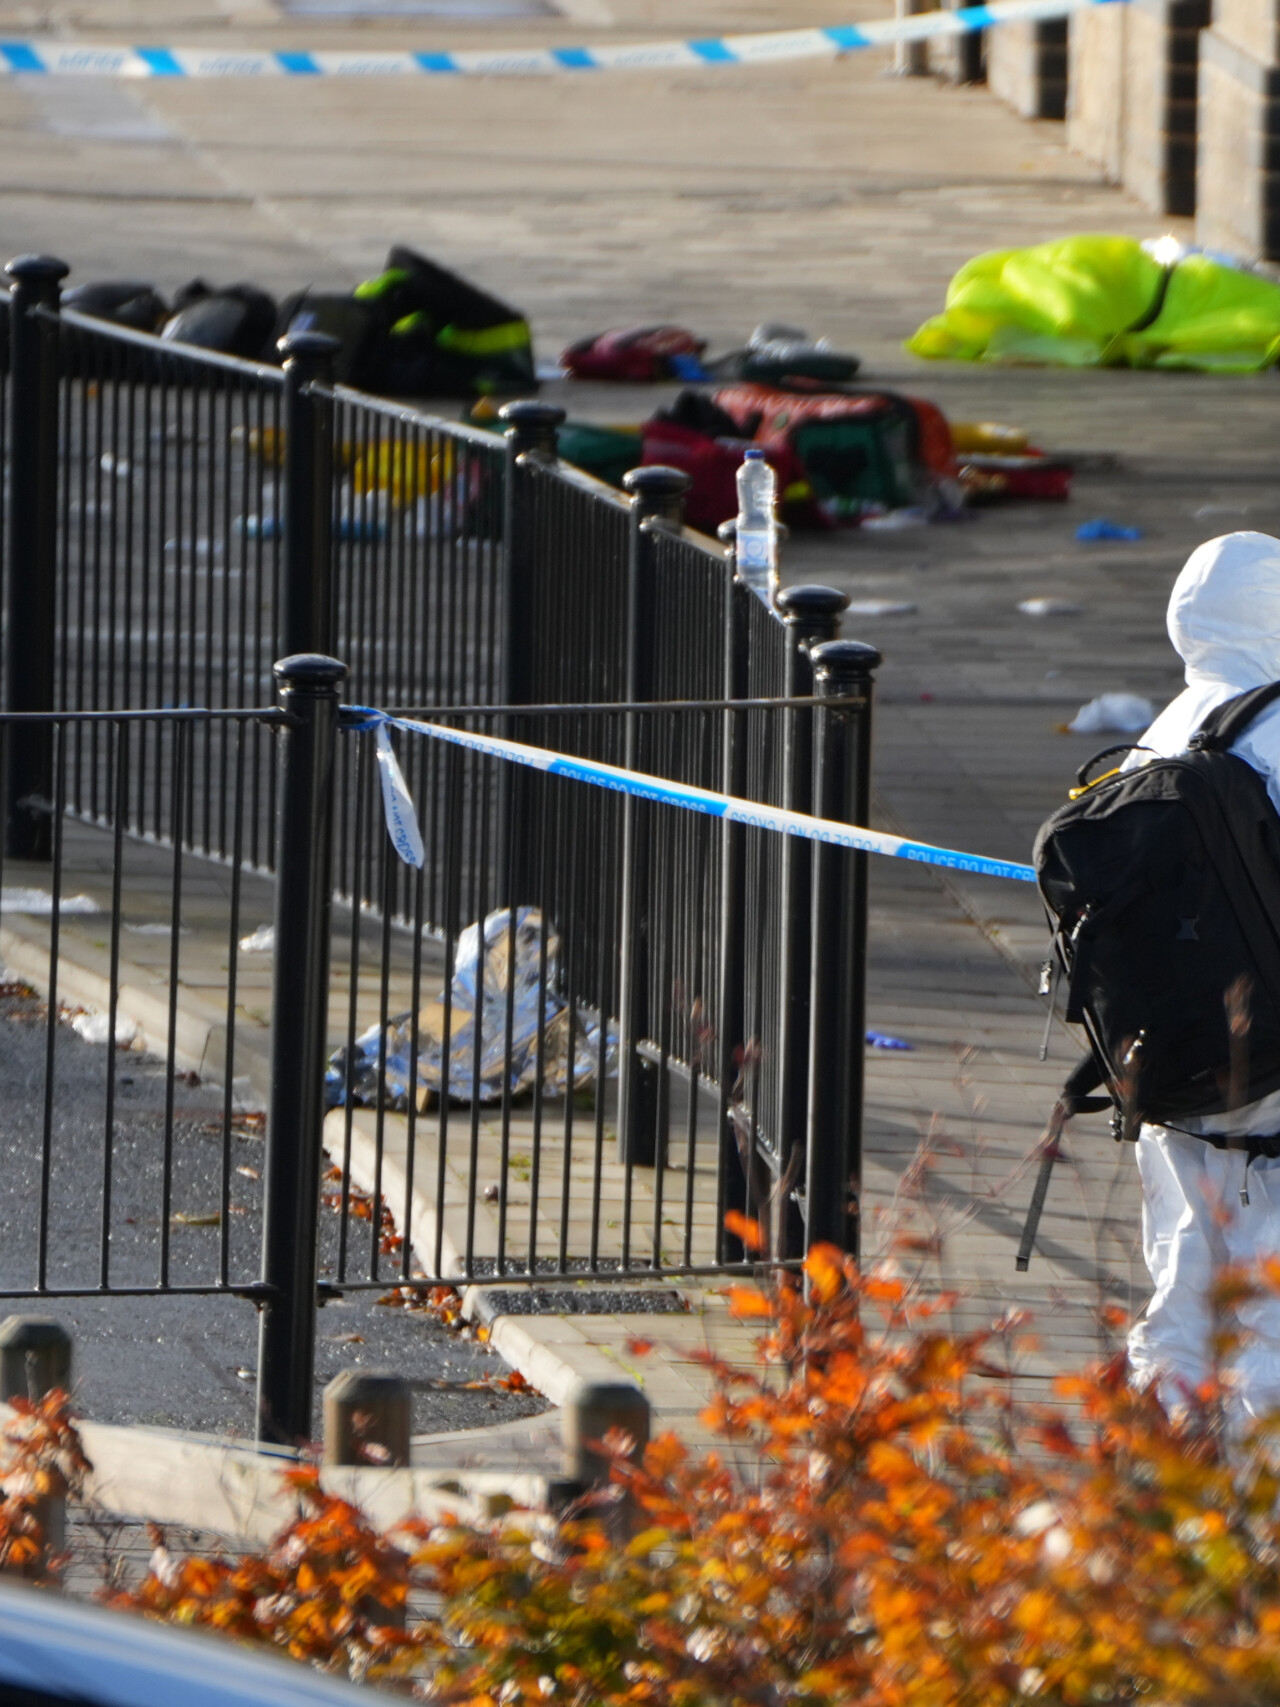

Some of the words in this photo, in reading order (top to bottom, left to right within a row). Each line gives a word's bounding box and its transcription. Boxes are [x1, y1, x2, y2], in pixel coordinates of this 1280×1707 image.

[907, 848, 957, 868] POLICE
[959, 859, 980, 873] DO
[982, 863, 1010, 878] NOT
